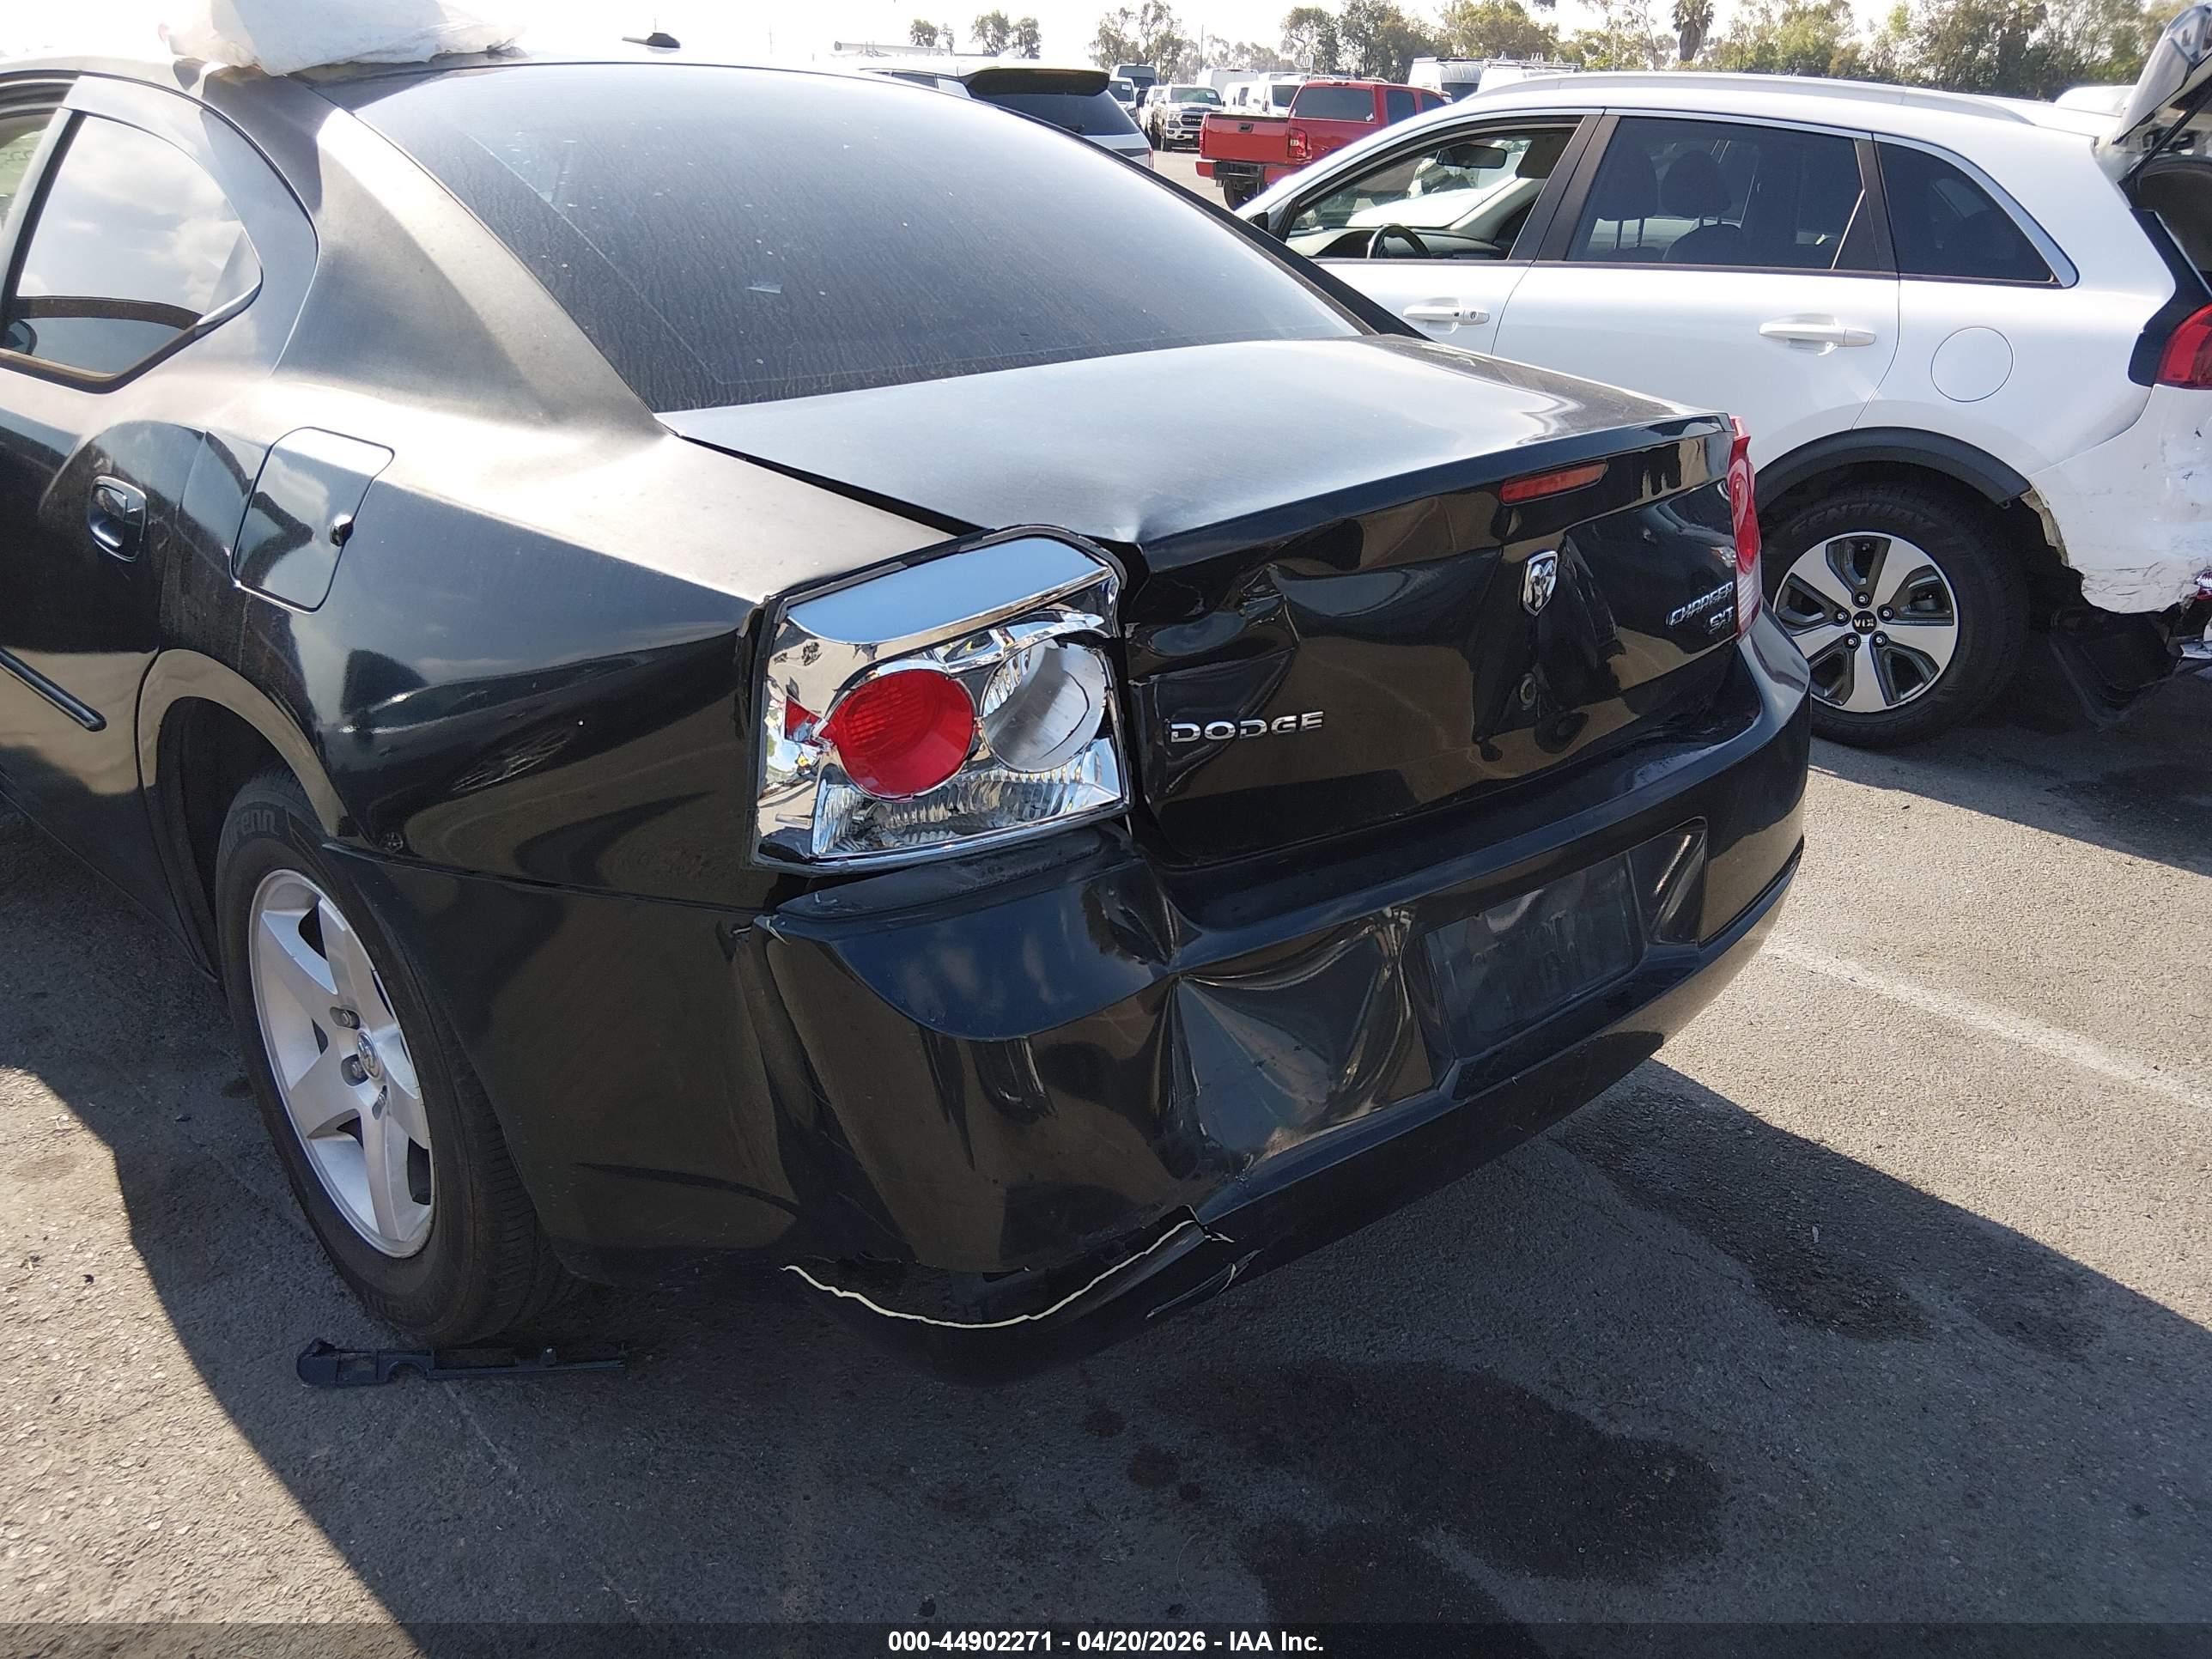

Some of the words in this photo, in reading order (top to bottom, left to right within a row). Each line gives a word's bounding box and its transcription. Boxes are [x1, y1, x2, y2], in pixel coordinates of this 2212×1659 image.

[1669, 581, 1734, 626] CHARGER
[1709, 606, 1734, 633] SXT
[1171, 711, 1323, 743] DODGE
